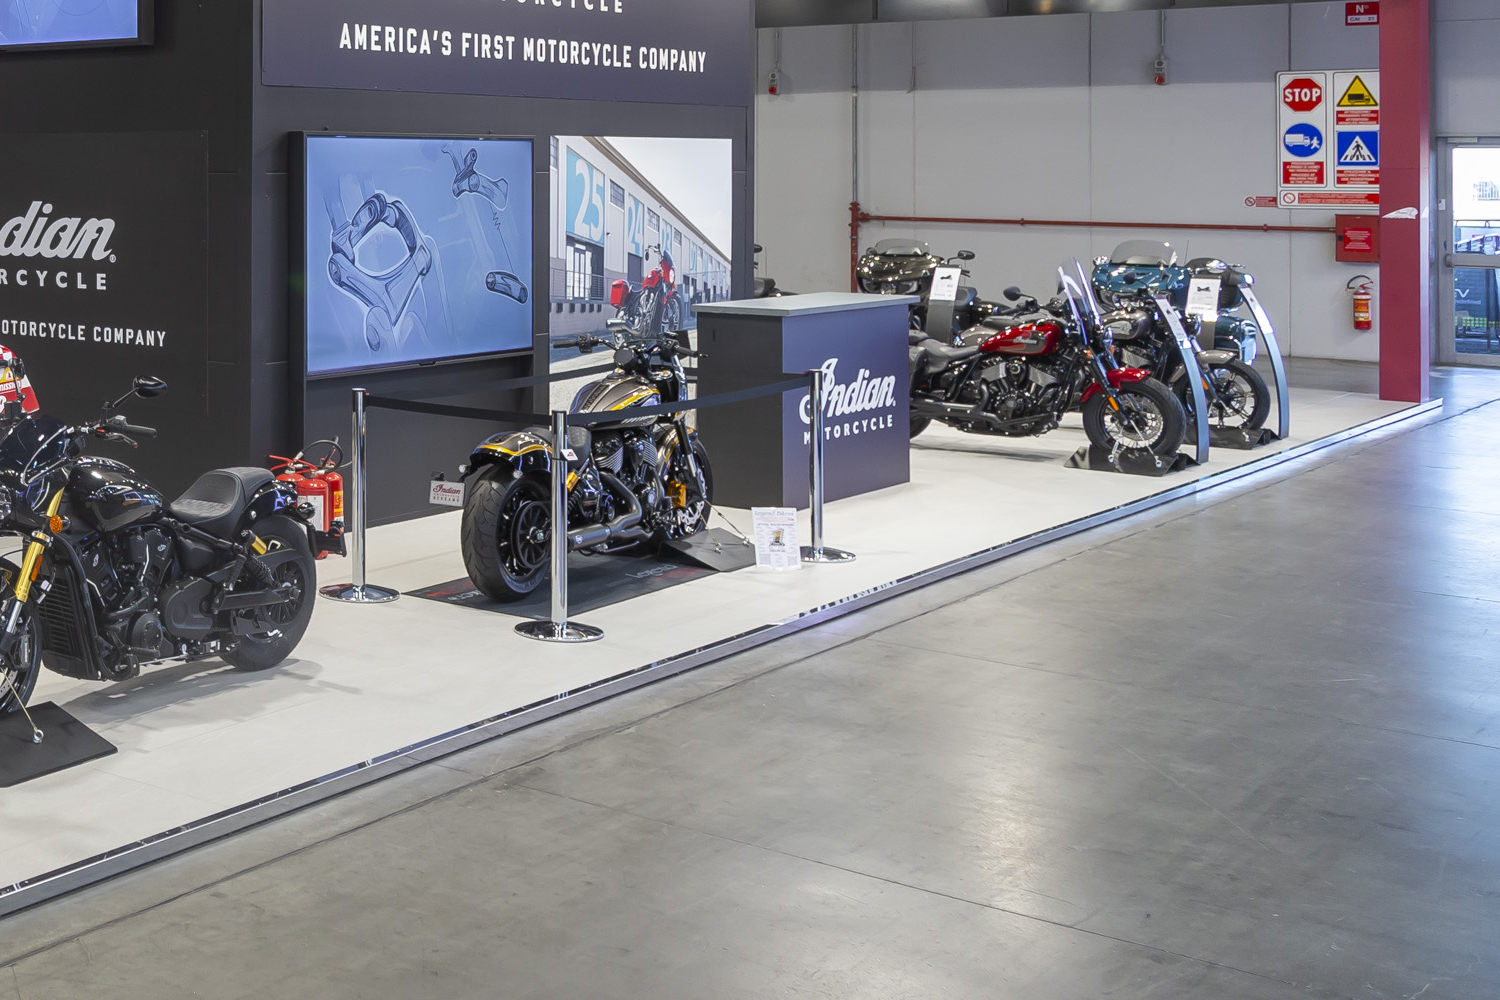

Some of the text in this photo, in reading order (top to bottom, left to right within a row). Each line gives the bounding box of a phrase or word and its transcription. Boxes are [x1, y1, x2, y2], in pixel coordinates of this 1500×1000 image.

[339, 22, 707, 73] AMERICA'S FIRST MOTORCYCLE COMPANY
[1284, 88, 1321, 103] STOP
[574, 158, 605, 243] 25
[93, 326, 167, 348] COMPANY
[804, 415, 893, 445] MTORCYCLE
[433, 484, 461, 494] Indian
